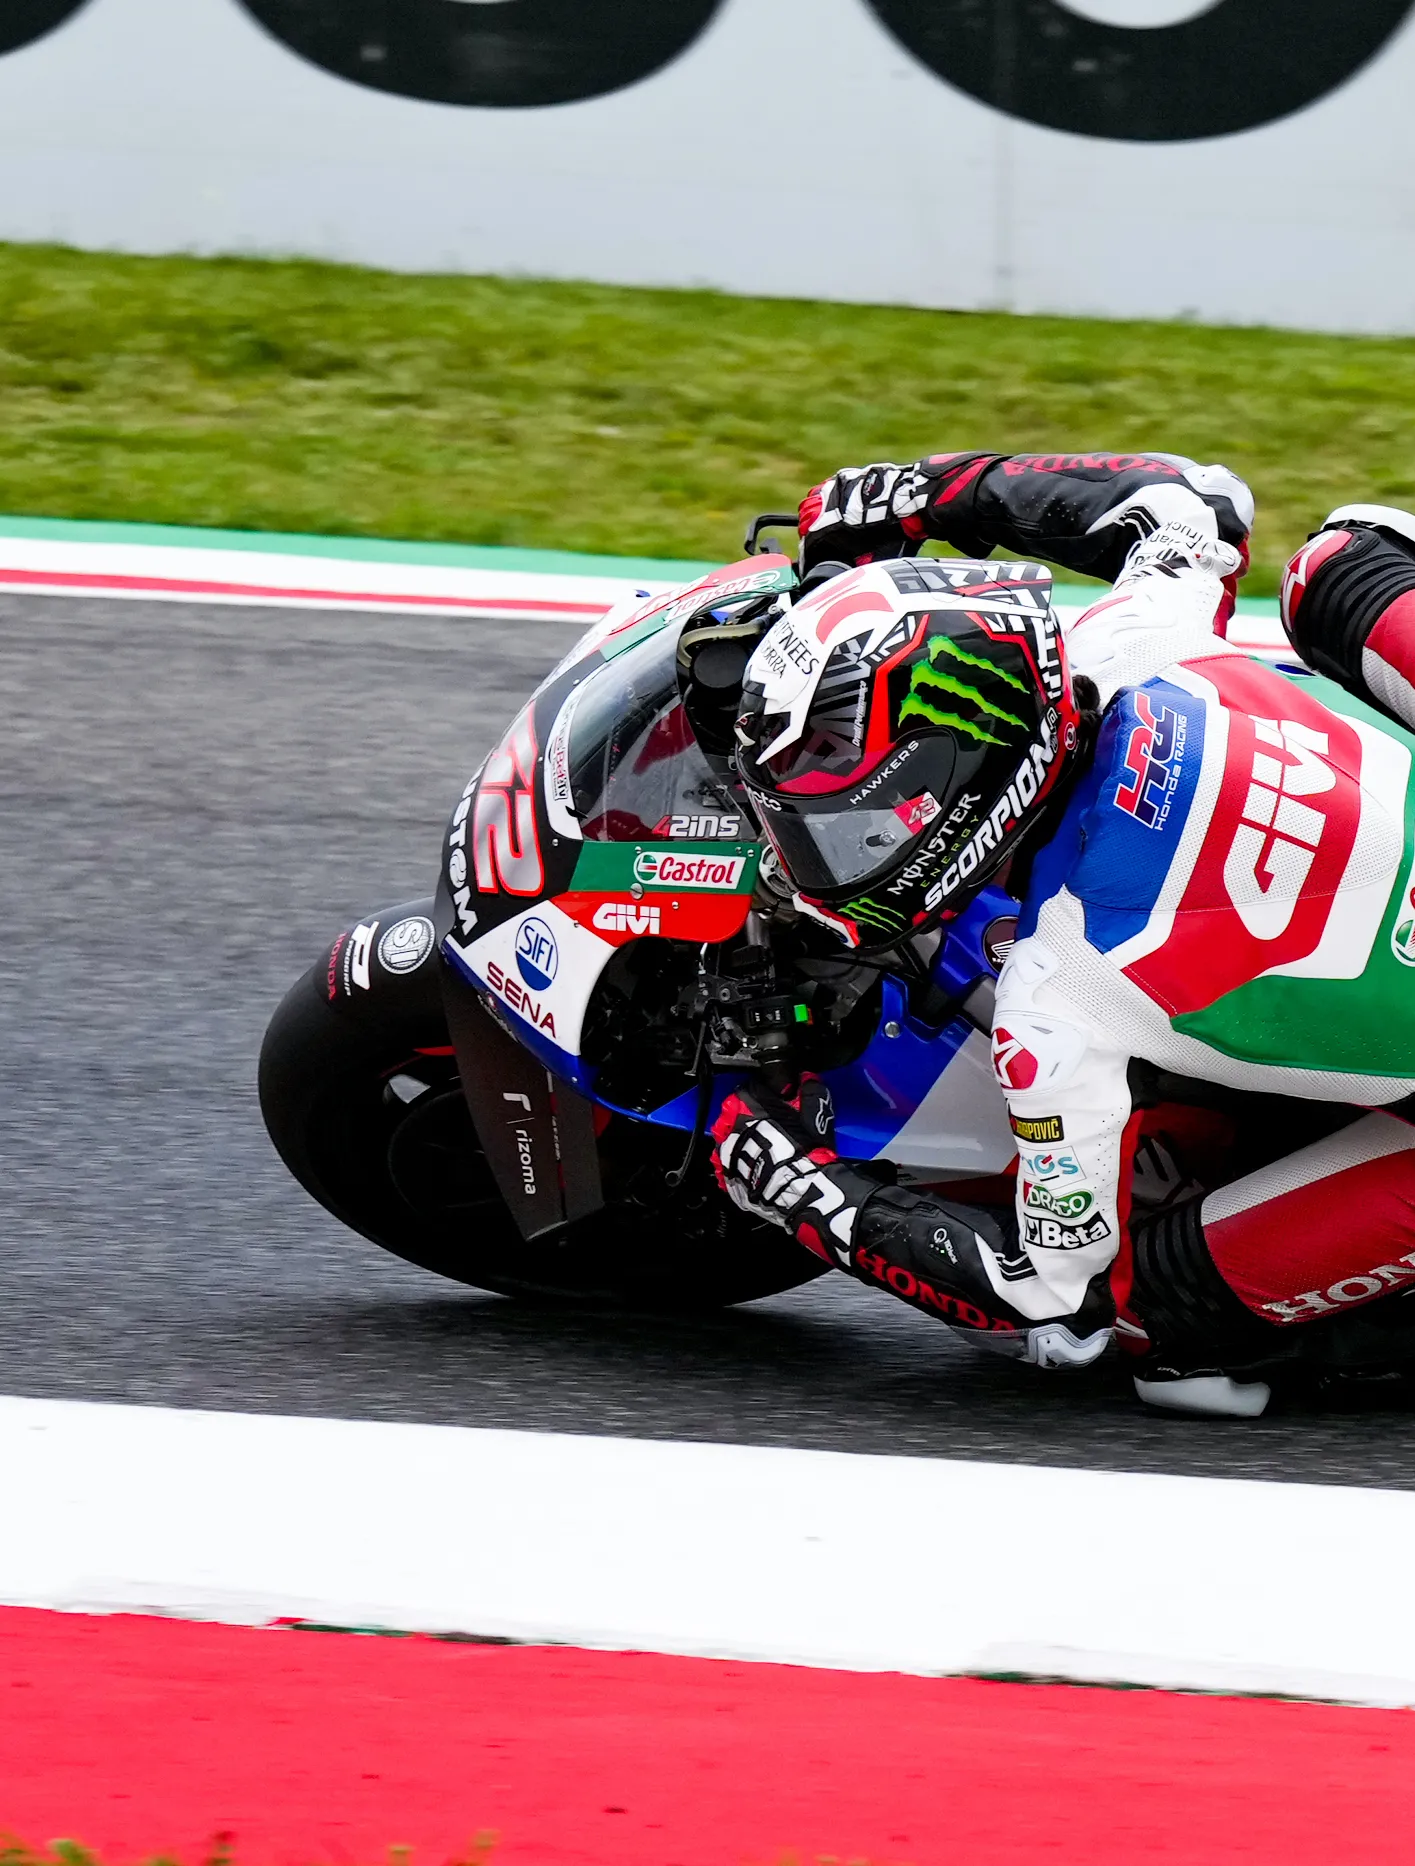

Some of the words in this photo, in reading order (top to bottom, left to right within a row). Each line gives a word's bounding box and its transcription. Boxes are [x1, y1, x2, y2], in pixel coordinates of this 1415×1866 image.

[850, 740, 920, 805] HAWKERS
[1113, 691, 1177, 829] HRC
[1154, 765, 1182, 831] Honda
[1174, 714, 1188, 762] RACING
[887, 793, 982, 895] MONSTER
[925, 717, 1054, 911] SCORPION
[1223, 714, 1337, 941] GIVI
[659, 857, 737, 884] Castrol
[920, 814, 980, 888] ENERGY
[519, 924, 554, 972] SIFI
[592, 902, 661, 935] GIVI
[327, 931, 348, 1001] HONDA
[487, 961, 557, 1039] SENA
[515, 1128, 537, 1196] rizoma
[1028, 1189, 1086, 1217] DRACO
[1041, 1220, 1108, 1249] Beta
